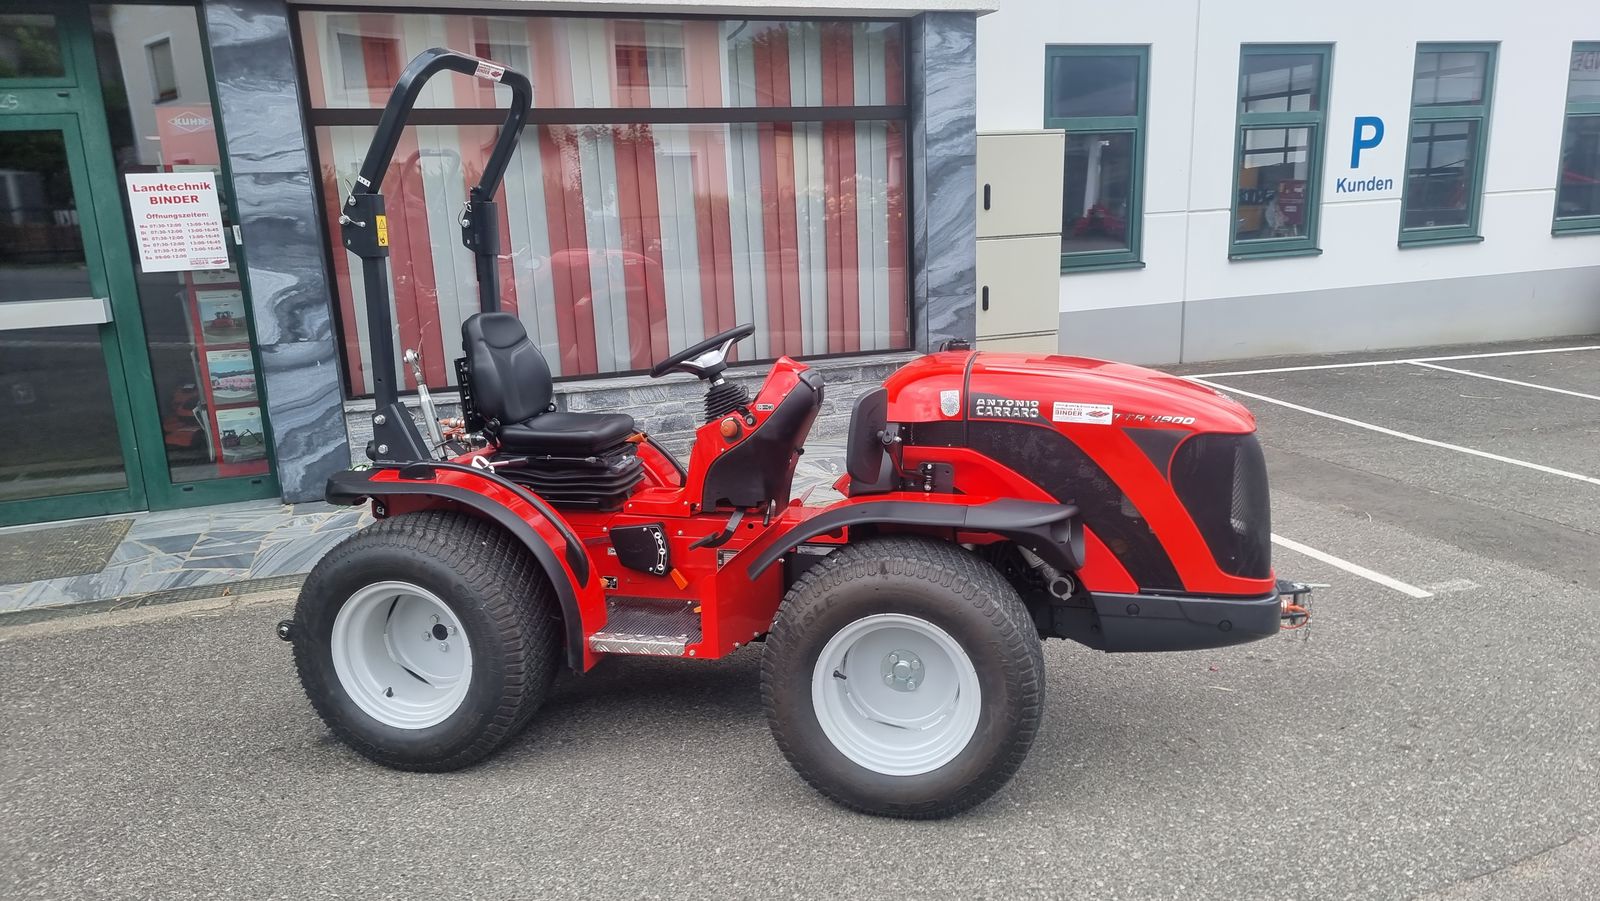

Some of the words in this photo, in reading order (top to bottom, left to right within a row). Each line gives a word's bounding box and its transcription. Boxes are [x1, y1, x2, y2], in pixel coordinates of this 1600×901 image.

[1350, 116, 1384, 169] P
[132, 182, 211, 192] Landtechnik
[1336, 176, 1393, 193] Kunden
[149, 195, 199, 205] BINDER
[146, 212, 209, 220] Öffnungszeiten:
[976, 398, 1040, 408] ANTONIO
[976, 406, 1040, 418] CARRARO
[1055, 409, 1083, 417] BINDER
